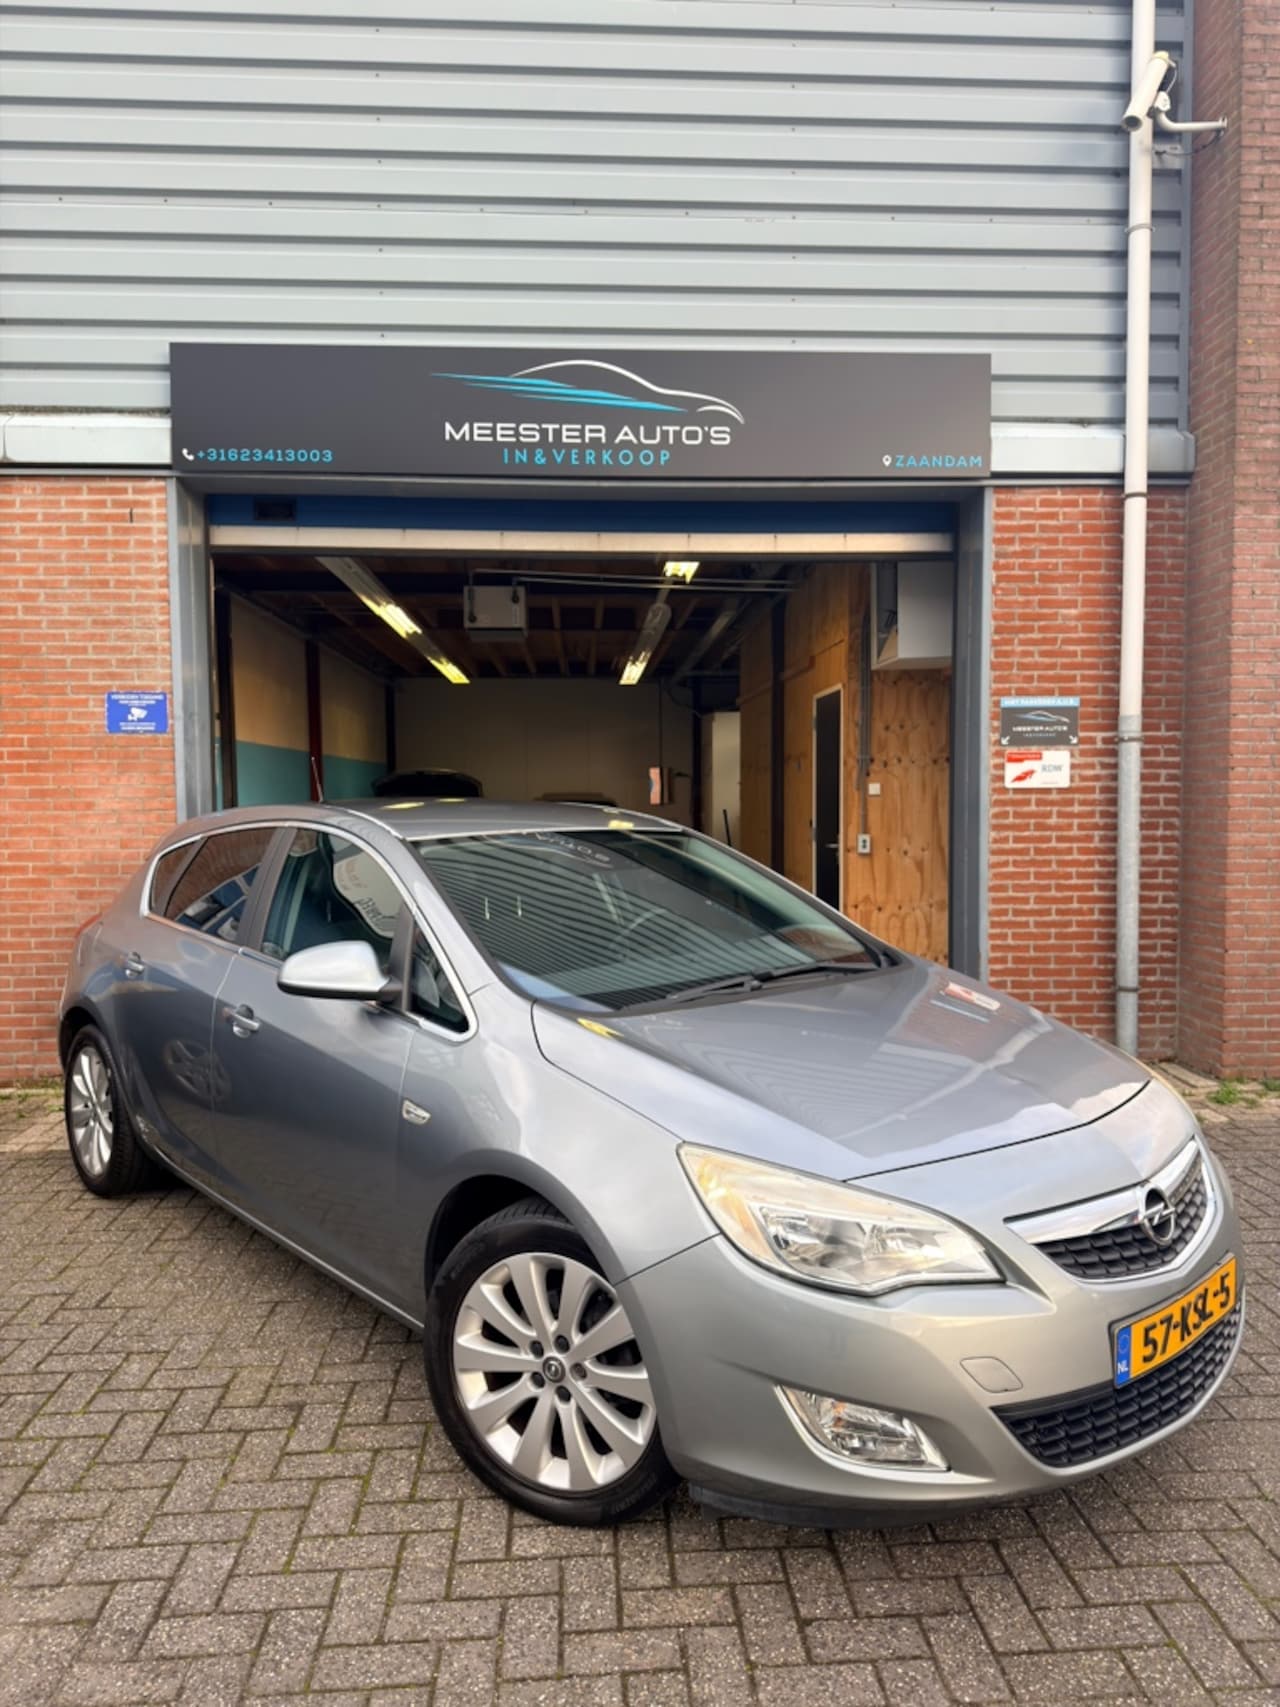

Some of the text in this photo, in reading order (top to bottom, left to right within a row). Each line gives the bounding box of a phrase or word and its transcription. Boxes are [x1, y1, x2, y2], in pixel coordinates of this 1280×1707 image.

[444, 421, 731, 446] MEESTER AUTO'S
[197, 448, 333, 463] +31623413003
[895, 454, 983, 468] ZAANDAM
[1142, 1271, 1231, 1364] 57-KSL-5
[1117, 1360, 1129, 1375] NL
